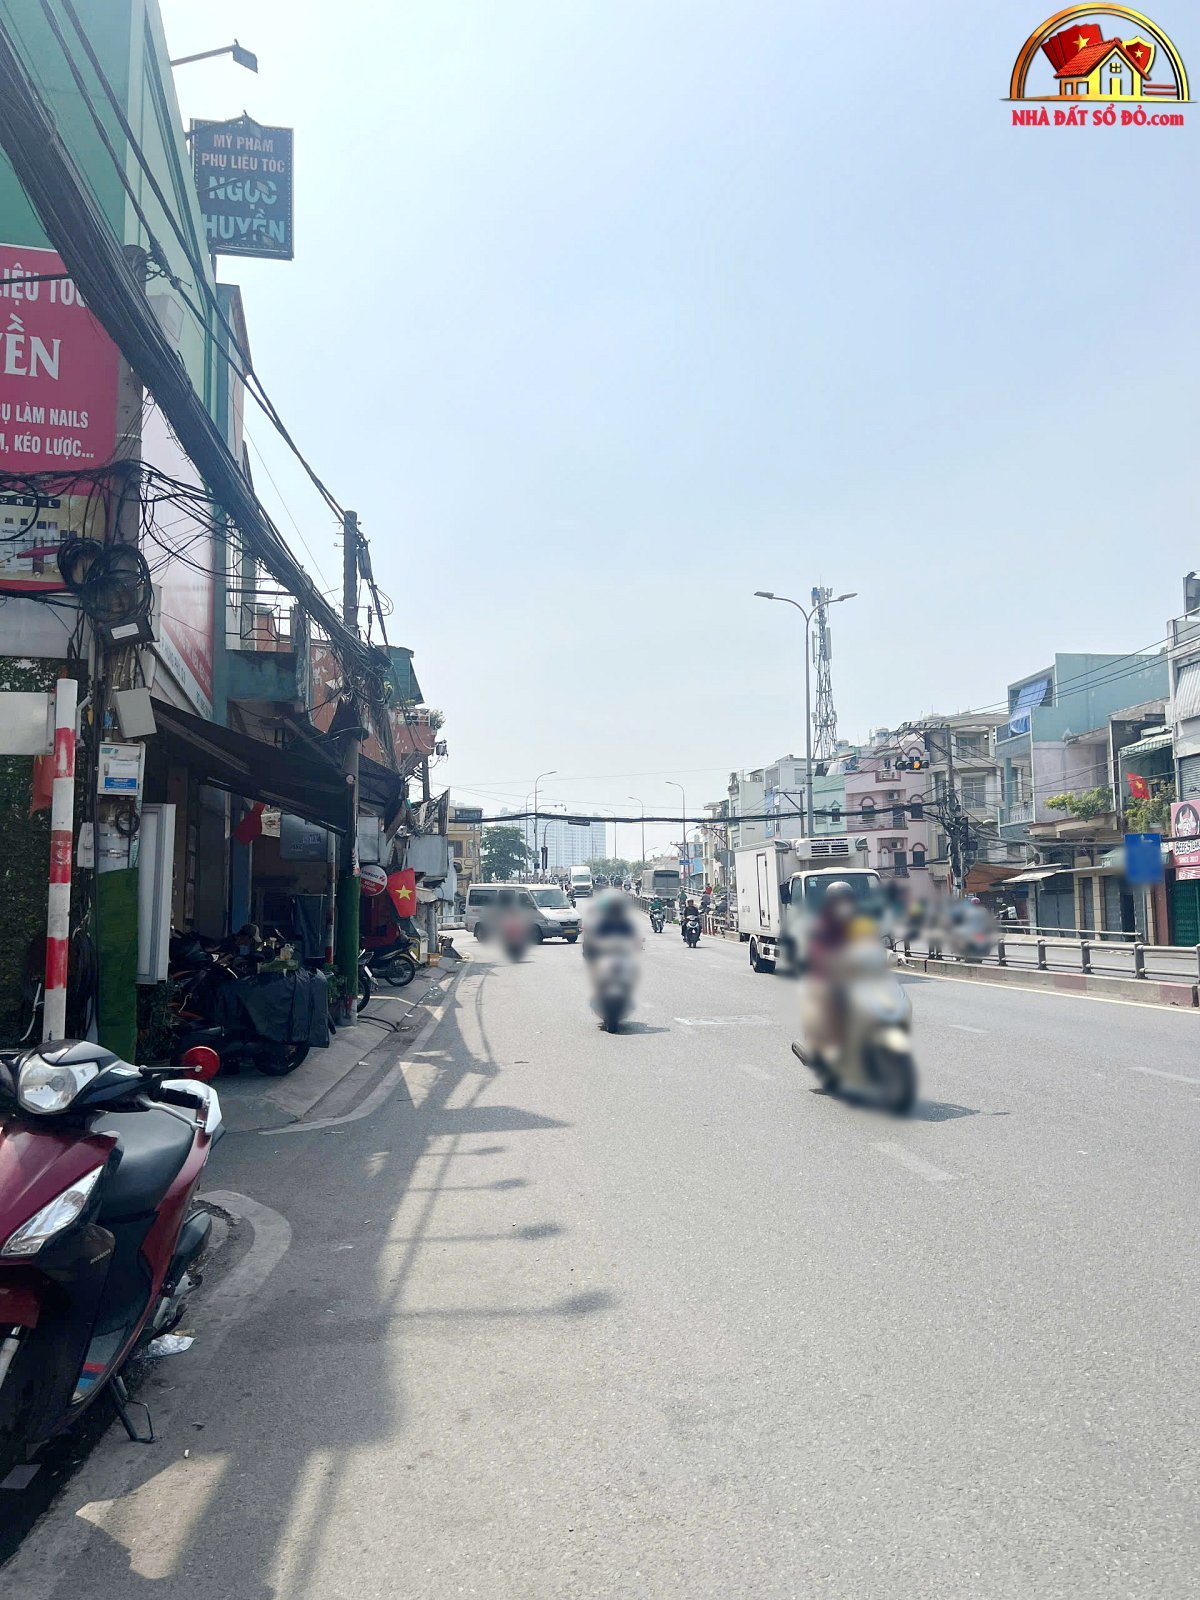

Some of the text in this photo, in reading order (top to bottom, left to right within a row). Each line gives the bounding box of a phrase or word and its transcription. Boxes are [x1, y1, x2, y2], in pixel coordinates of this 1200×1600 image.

[201, 152, 227, 171] PHỤ
[261, 156, 286, 174] TÓC
[208, 175, 278, 210] NGỌC
[202, 207, 285, 244] HUYỀN
[0, 262, 39, 306] IỆU
[0, 312, 62, 381] ỀN
[15, 401, 45, 425] LÀM
[49, 408, 89, 429] NAILS
[14, 431, 41, 454] KÉO
[45, 436, 95, 460] LƯỢC...
